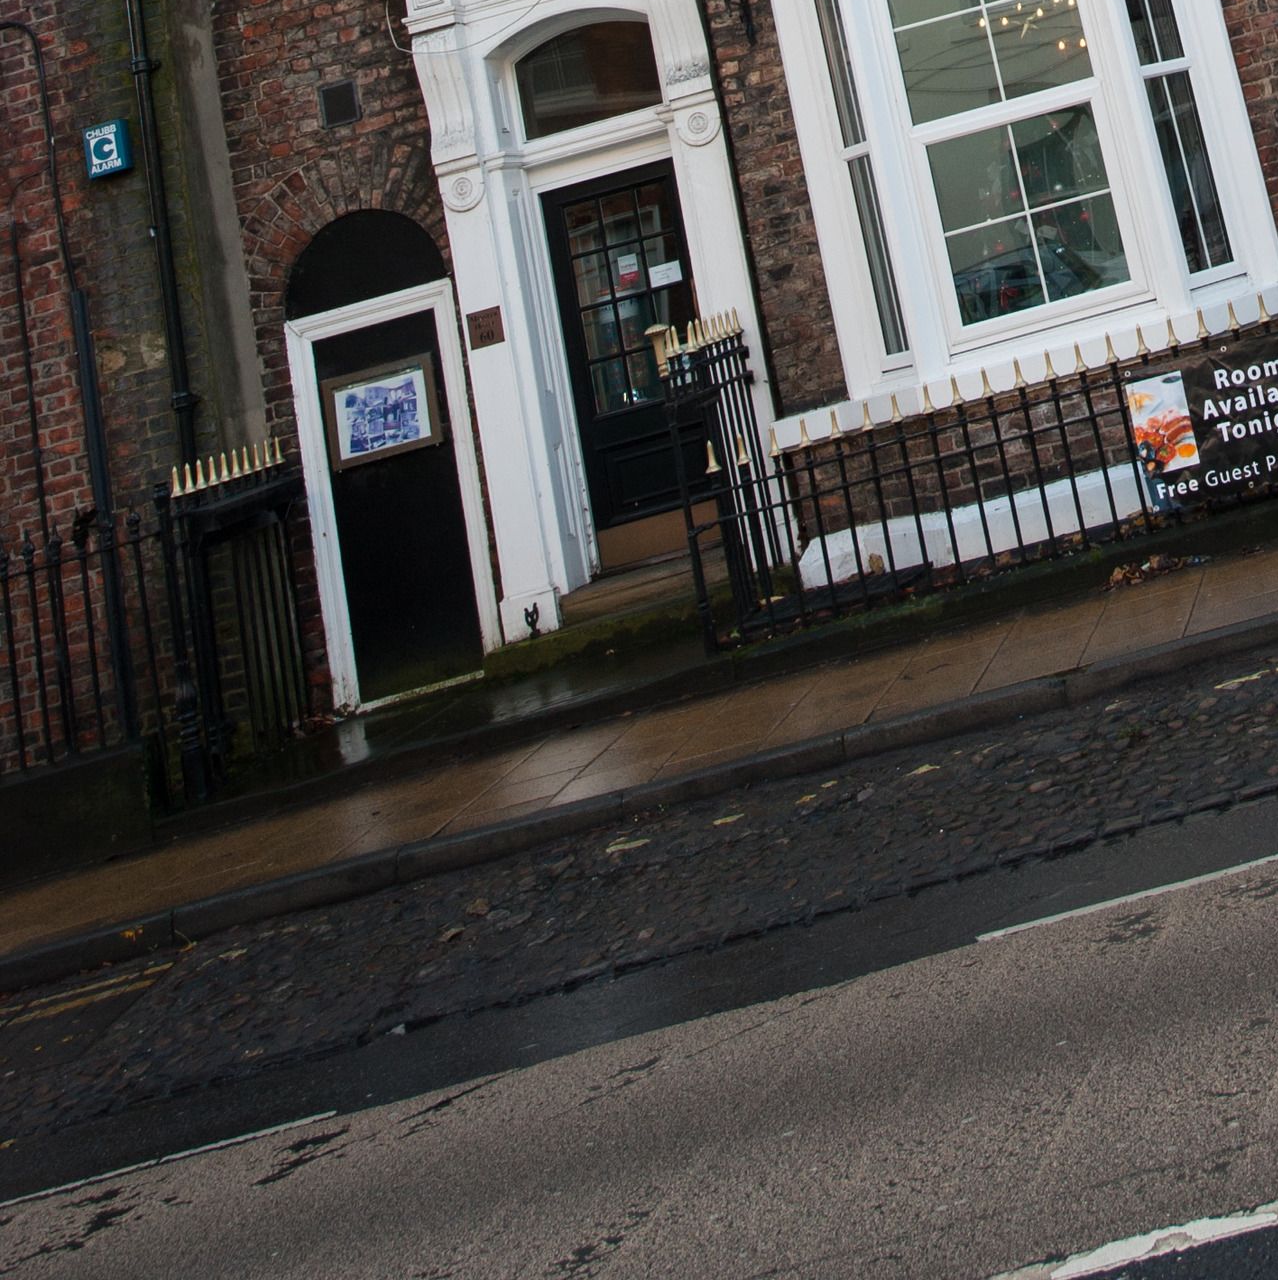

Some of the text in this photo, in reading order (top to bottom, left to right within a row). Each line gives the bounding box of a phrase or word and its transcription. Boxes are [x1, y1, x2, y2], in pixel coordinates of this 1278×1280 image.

[86, 123, 117, 140] CHUBB
[91, 157, 122, 175] ALARM
[479, 329, 495, 343] 60
[1156, 477, 1200, 500] Free
[1204, 460, 1261, 488] Guest
